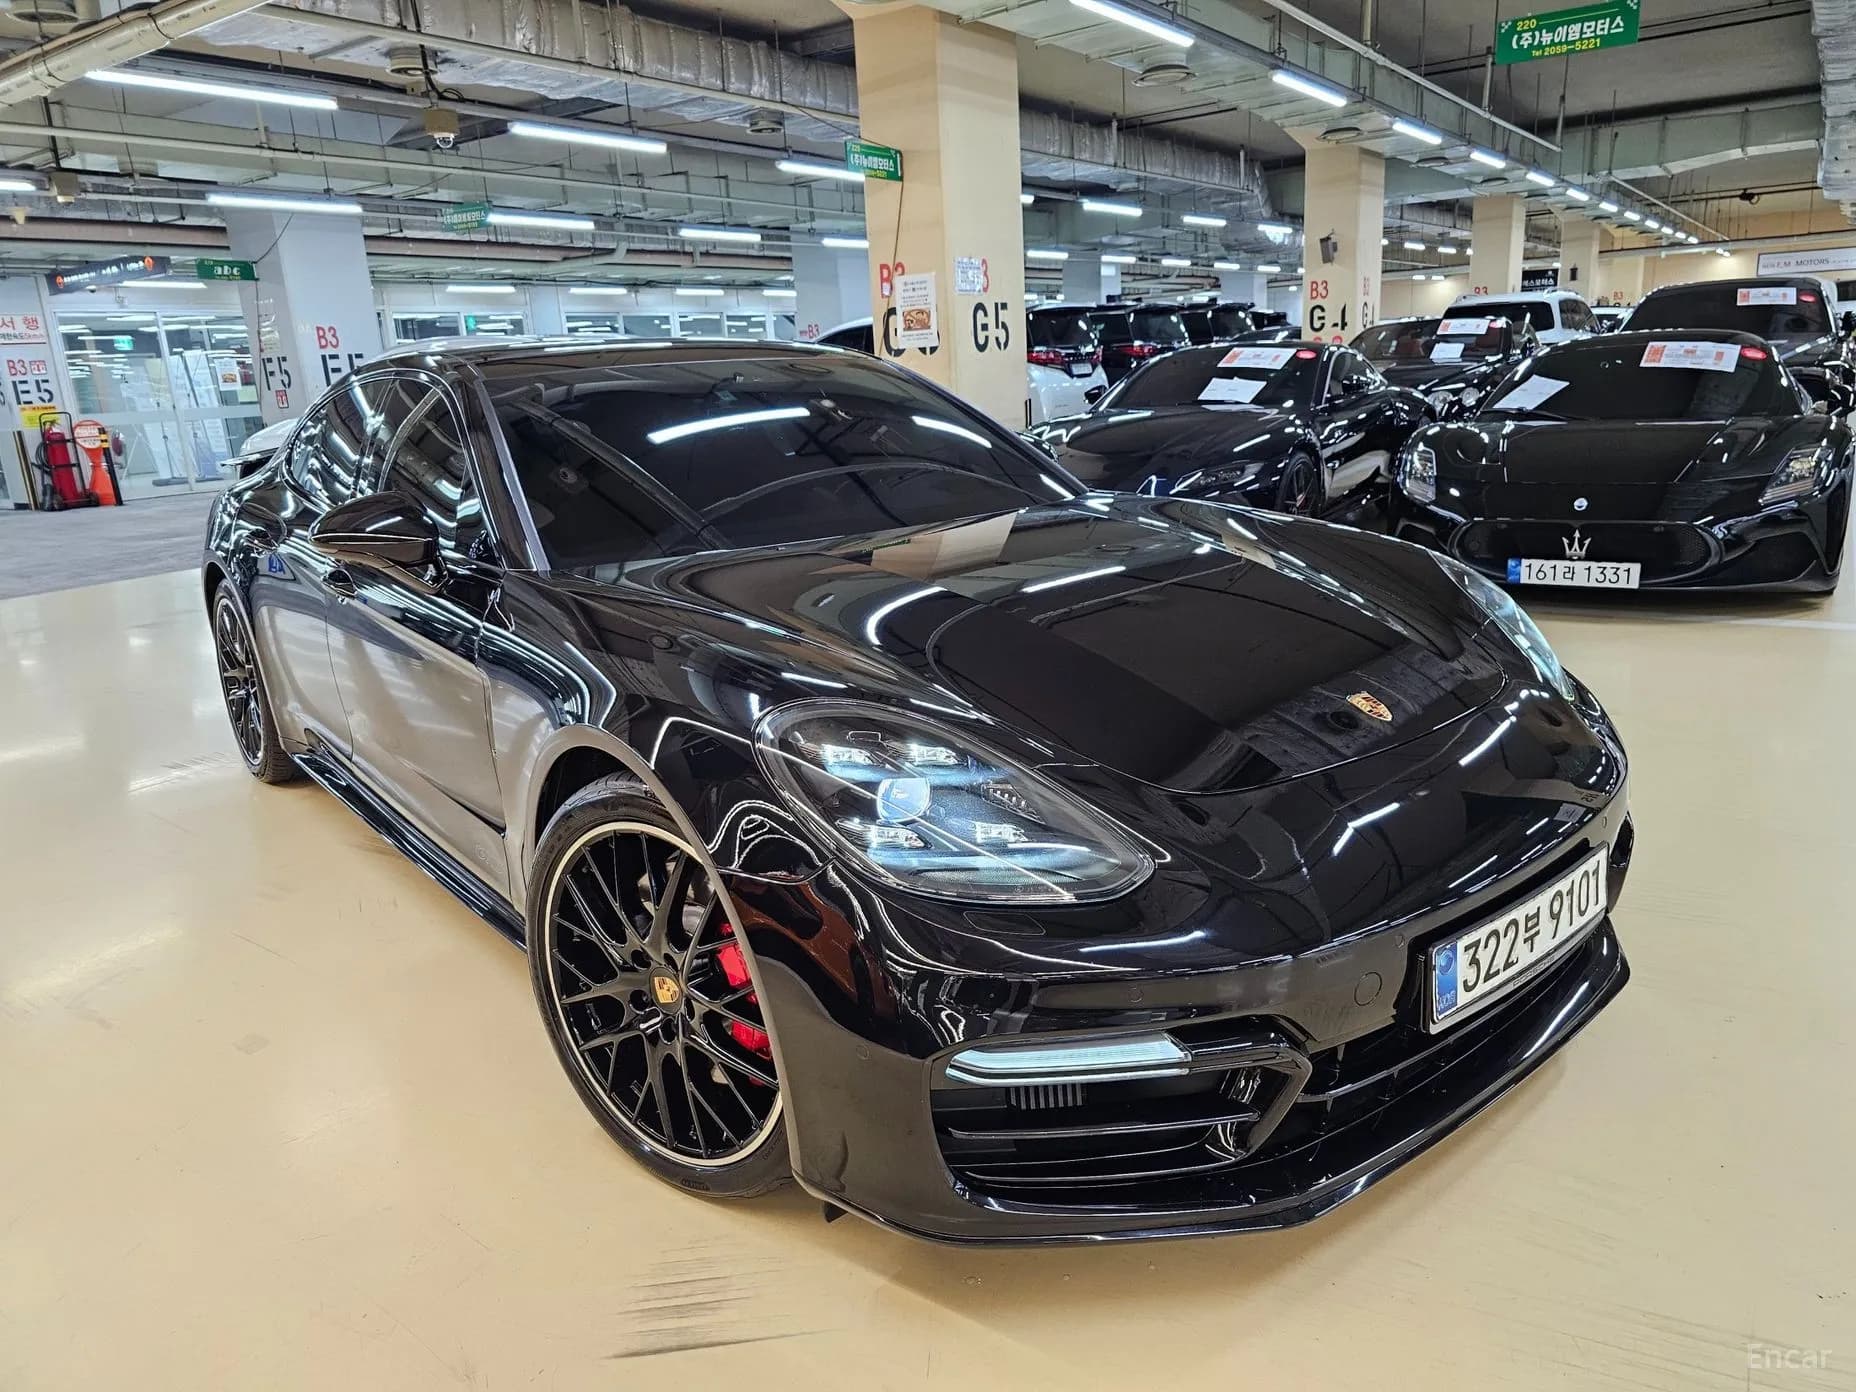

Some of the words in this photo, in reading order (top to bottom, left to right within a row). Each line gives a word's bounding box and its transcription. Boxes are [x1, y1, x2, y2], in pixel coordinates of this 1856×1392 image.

[1511, 15, 1625, 49] (주)뉴이엠모터스
[1516, 19, 1537, 31] 220
[1544, 38, 1601, 56] 2059-5221
[213, 264, 242, 276] abc
[1310, 279, 1329, 300] B3
[316, 326, 340, 349] B3
[973, 302, 1010, 353] G5
[7, 359, 28, 376] B3
[261, 356, 292, 391] F5
[12, 378, 54, 406] E5
[1525, 563, 1576, 582] 161라
[1584, 565, 1631, 585] 1331
[1462, 905, 1541, 993] 322부
[1549, 860, 1601, 940] 9101
